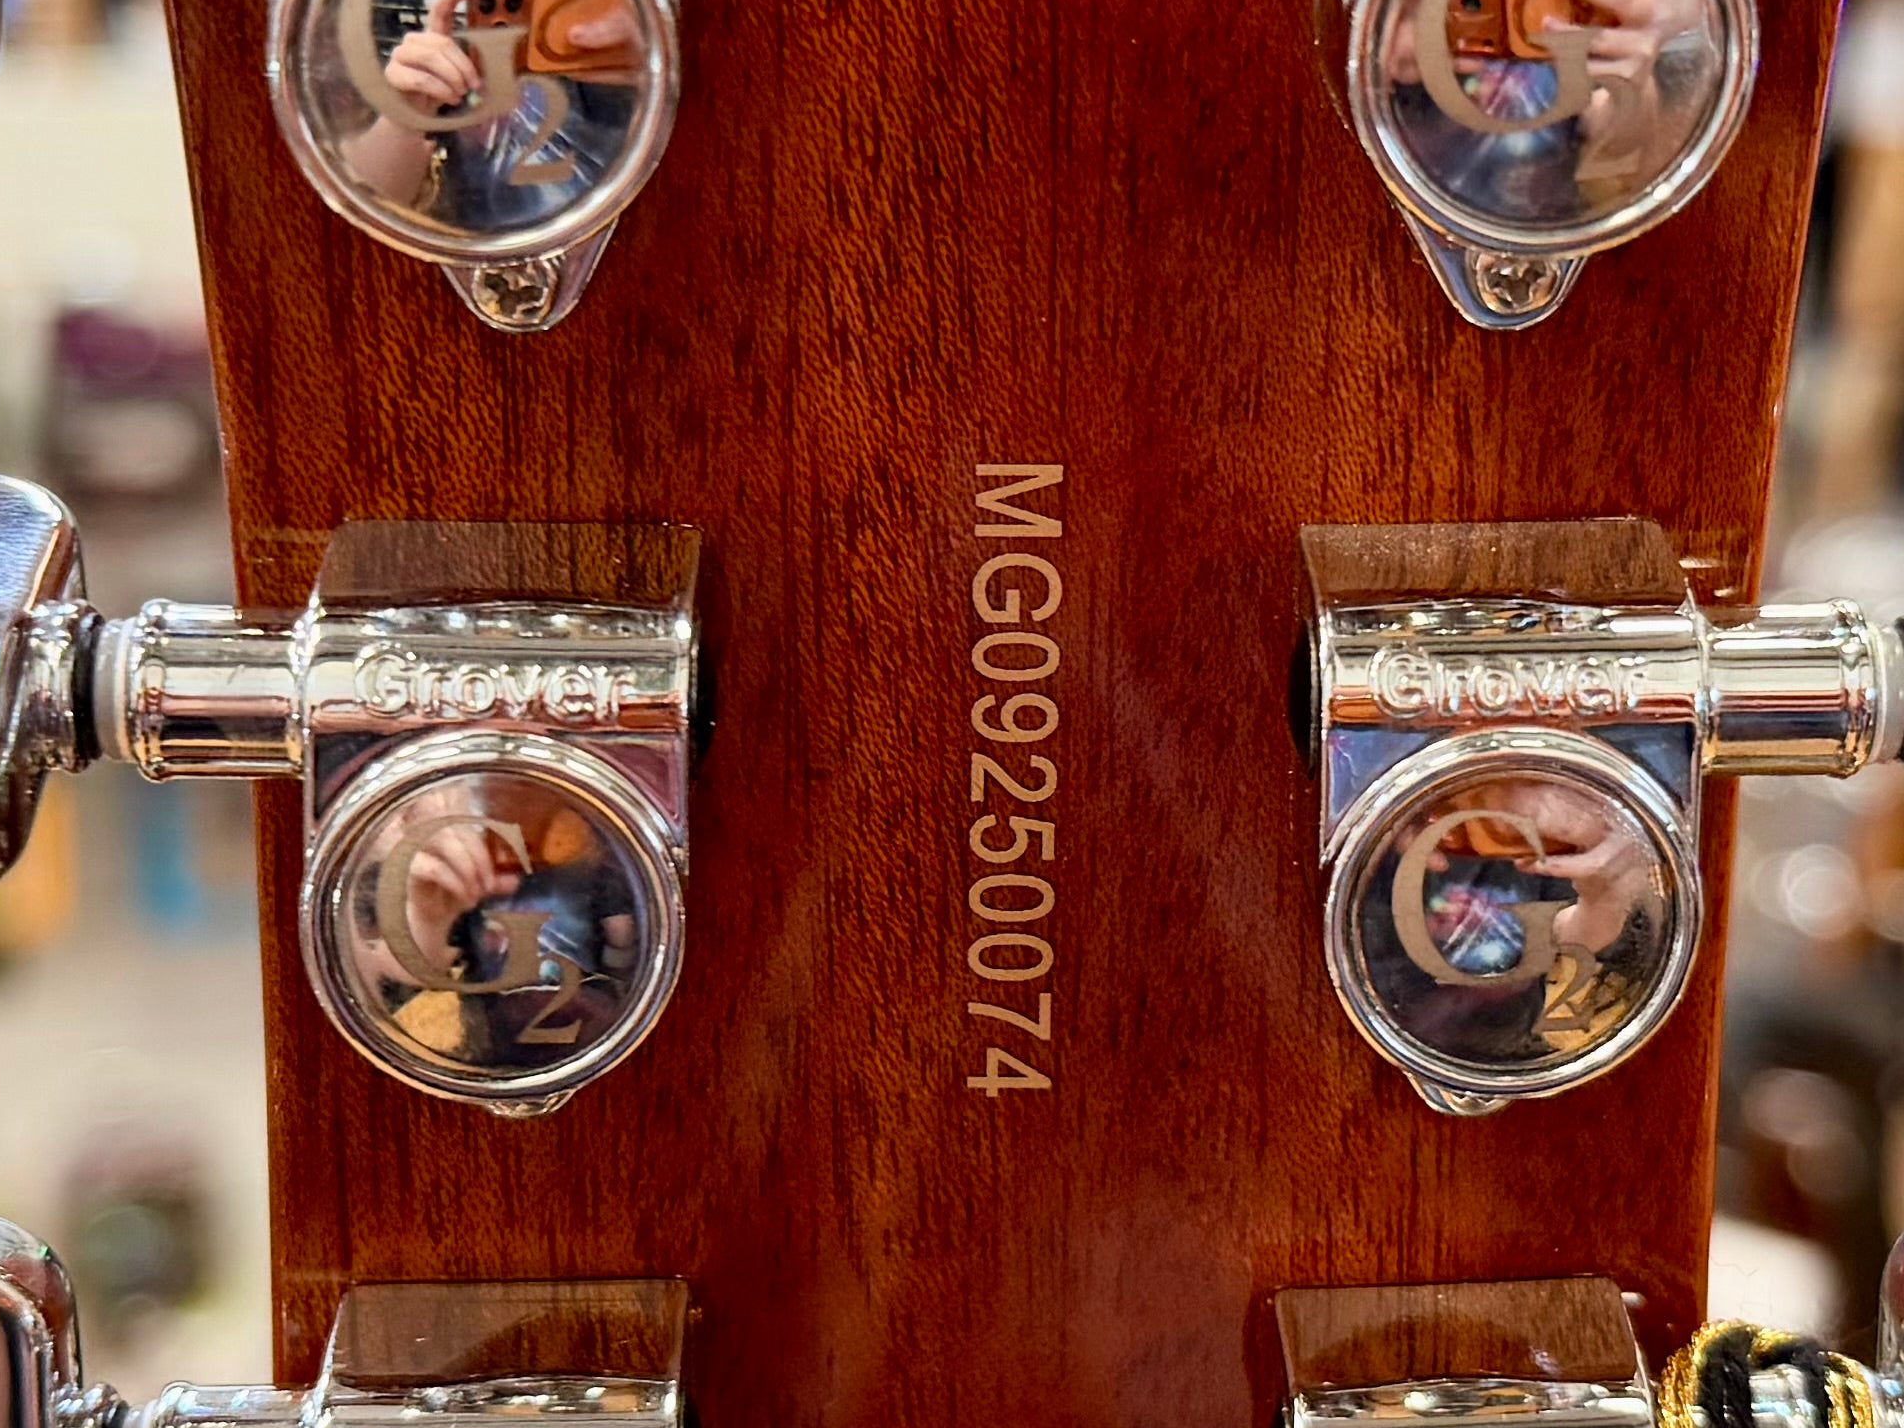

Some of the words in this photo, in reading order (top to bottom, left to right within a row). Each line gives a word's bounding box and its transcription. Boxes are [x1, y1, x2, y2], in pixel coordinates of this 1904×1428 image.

[354, 642, 635, 721] Grover
[1368, 642, 1648, 720] Grover
[966, 463, 1064, 1098] MG09250074
